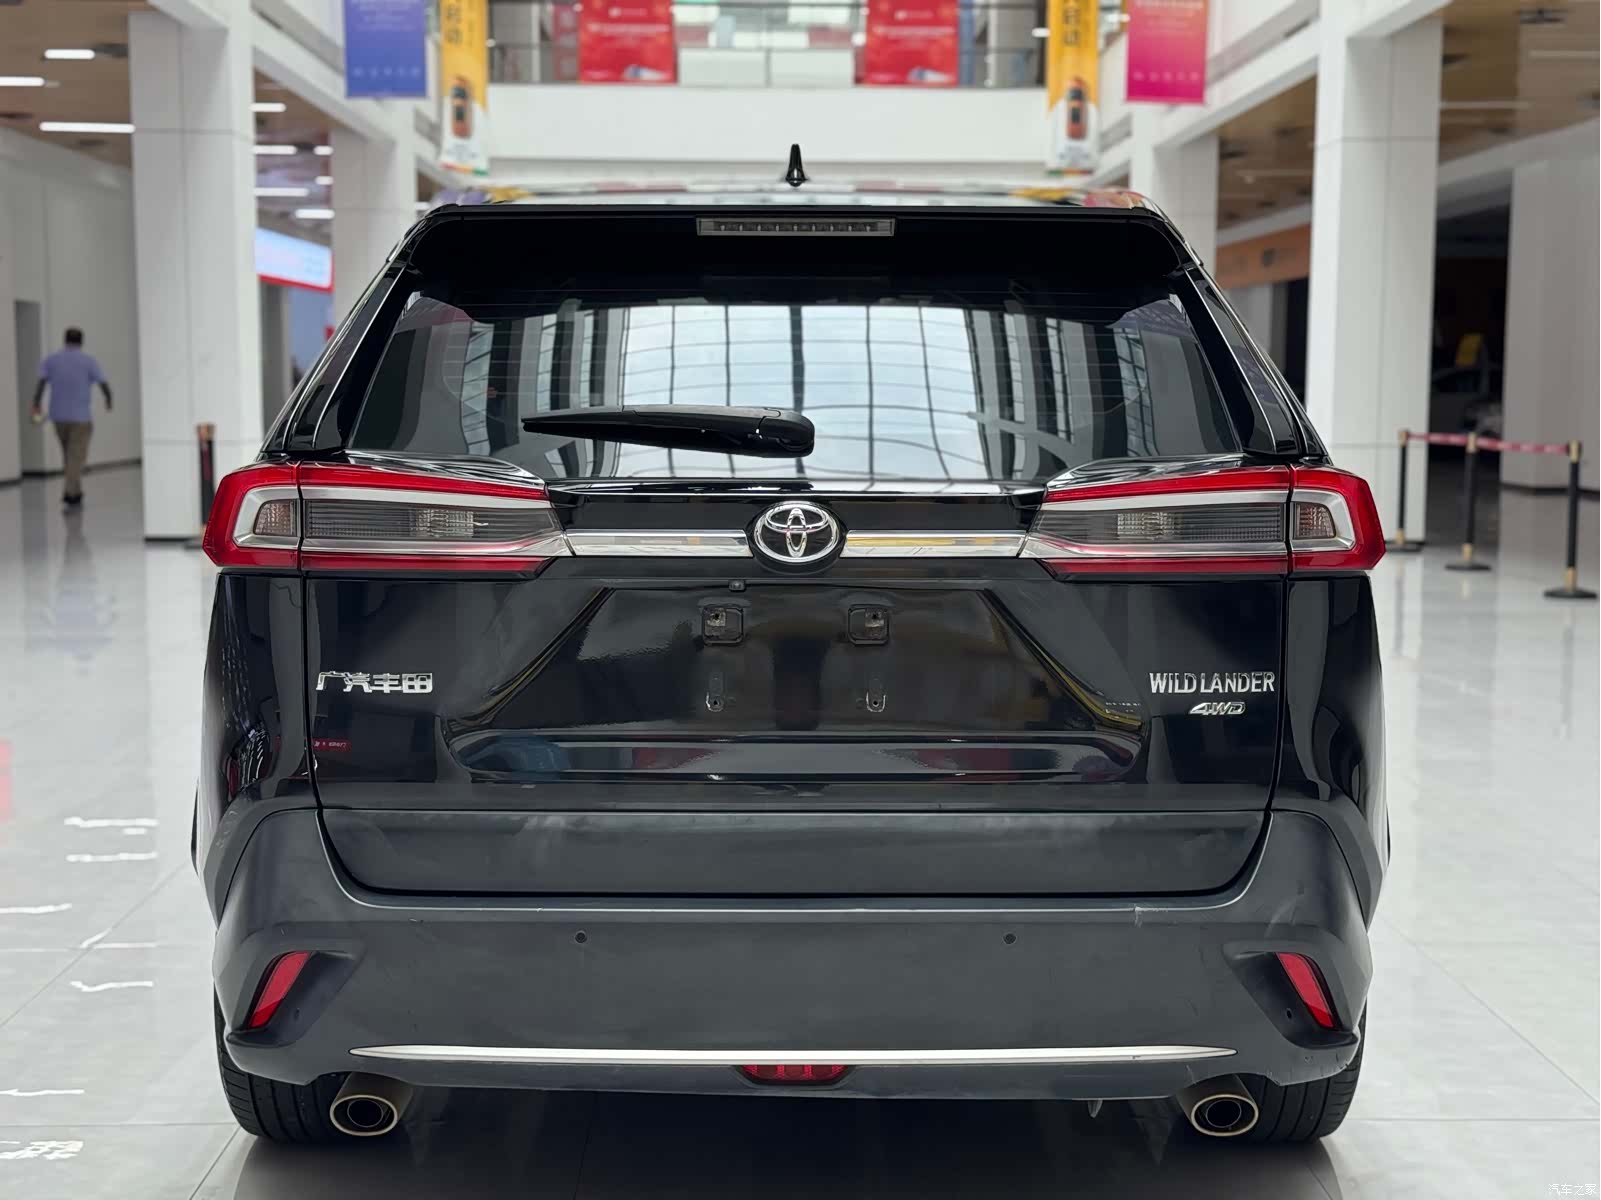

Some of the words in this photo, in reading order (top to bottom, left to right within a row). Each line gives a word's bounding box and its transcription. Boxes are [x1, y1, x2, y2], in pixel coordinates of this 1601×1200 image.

[316, 670, 433, 694] 广汽丰田
[1189, 701, 1246, 716] 4WD
